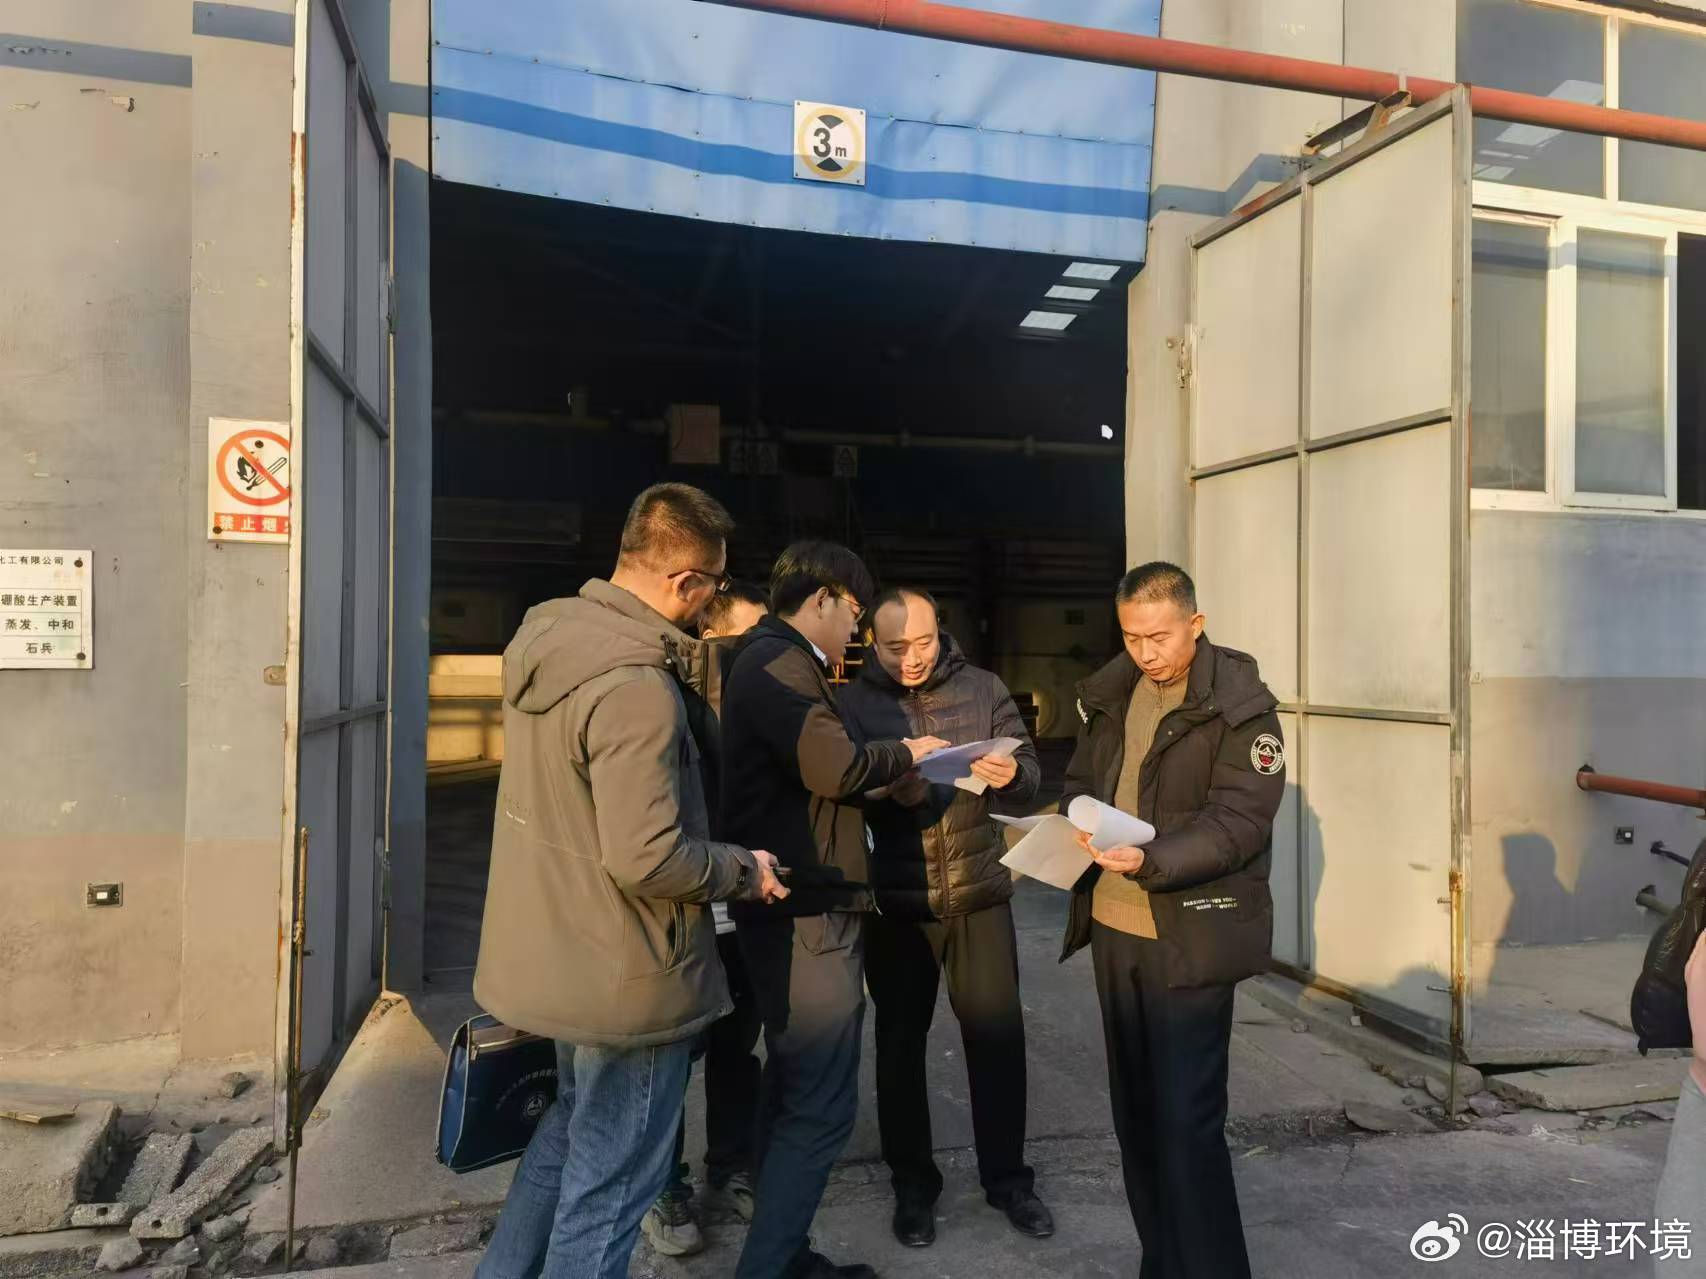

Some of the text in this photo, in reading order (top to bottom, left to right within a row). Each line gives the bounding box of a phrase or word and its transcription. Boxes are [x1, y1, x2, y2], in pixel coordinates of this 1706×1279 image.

[1, 594, 77, 606] 硼酸生产装置
[25, 642, 53, 654] 石兵
